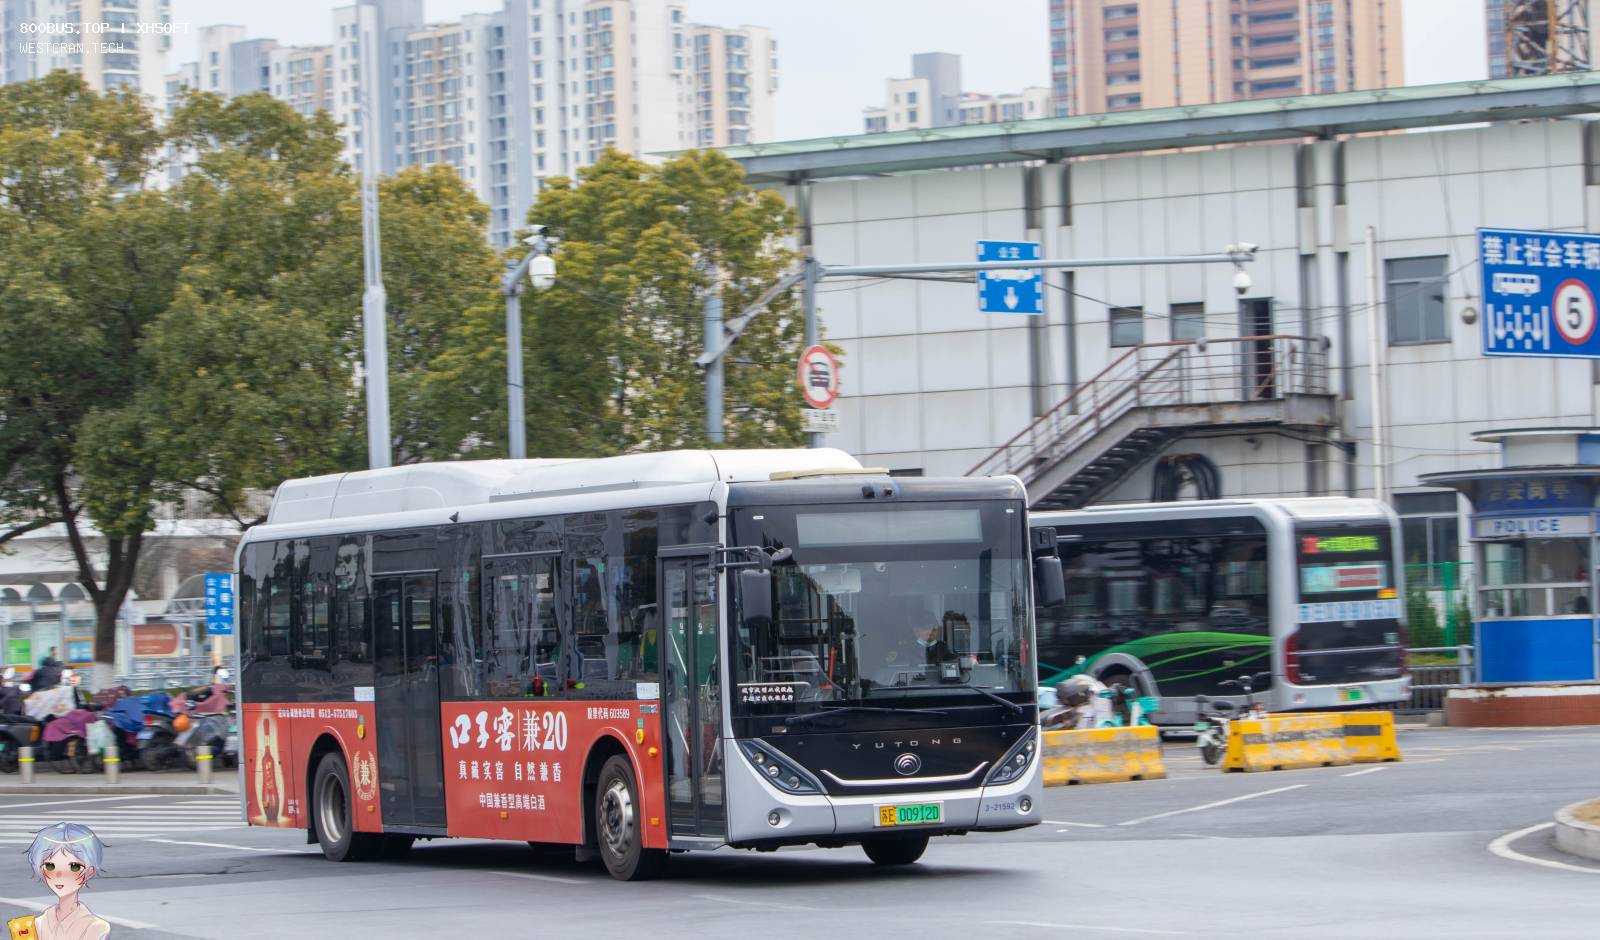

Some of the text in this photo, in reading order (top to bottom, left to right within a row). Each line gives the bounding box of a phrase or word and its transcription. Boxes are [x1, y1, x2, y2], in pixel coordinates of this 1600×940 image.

[1567, 296, 1582, 330] 5
[1493, 519, 1561, 533] POLICE
[609, 708, 630, 720] 603589
[450, 706, 568, 752] 口子窖 兼20
[852, 737, 962, 750] YUTONG
[360, 759, 371, 785] 兼
[514, 761, 562, 783] 自然兼香
[479, 792, 545, 811] 中国兼香型高端白酒
